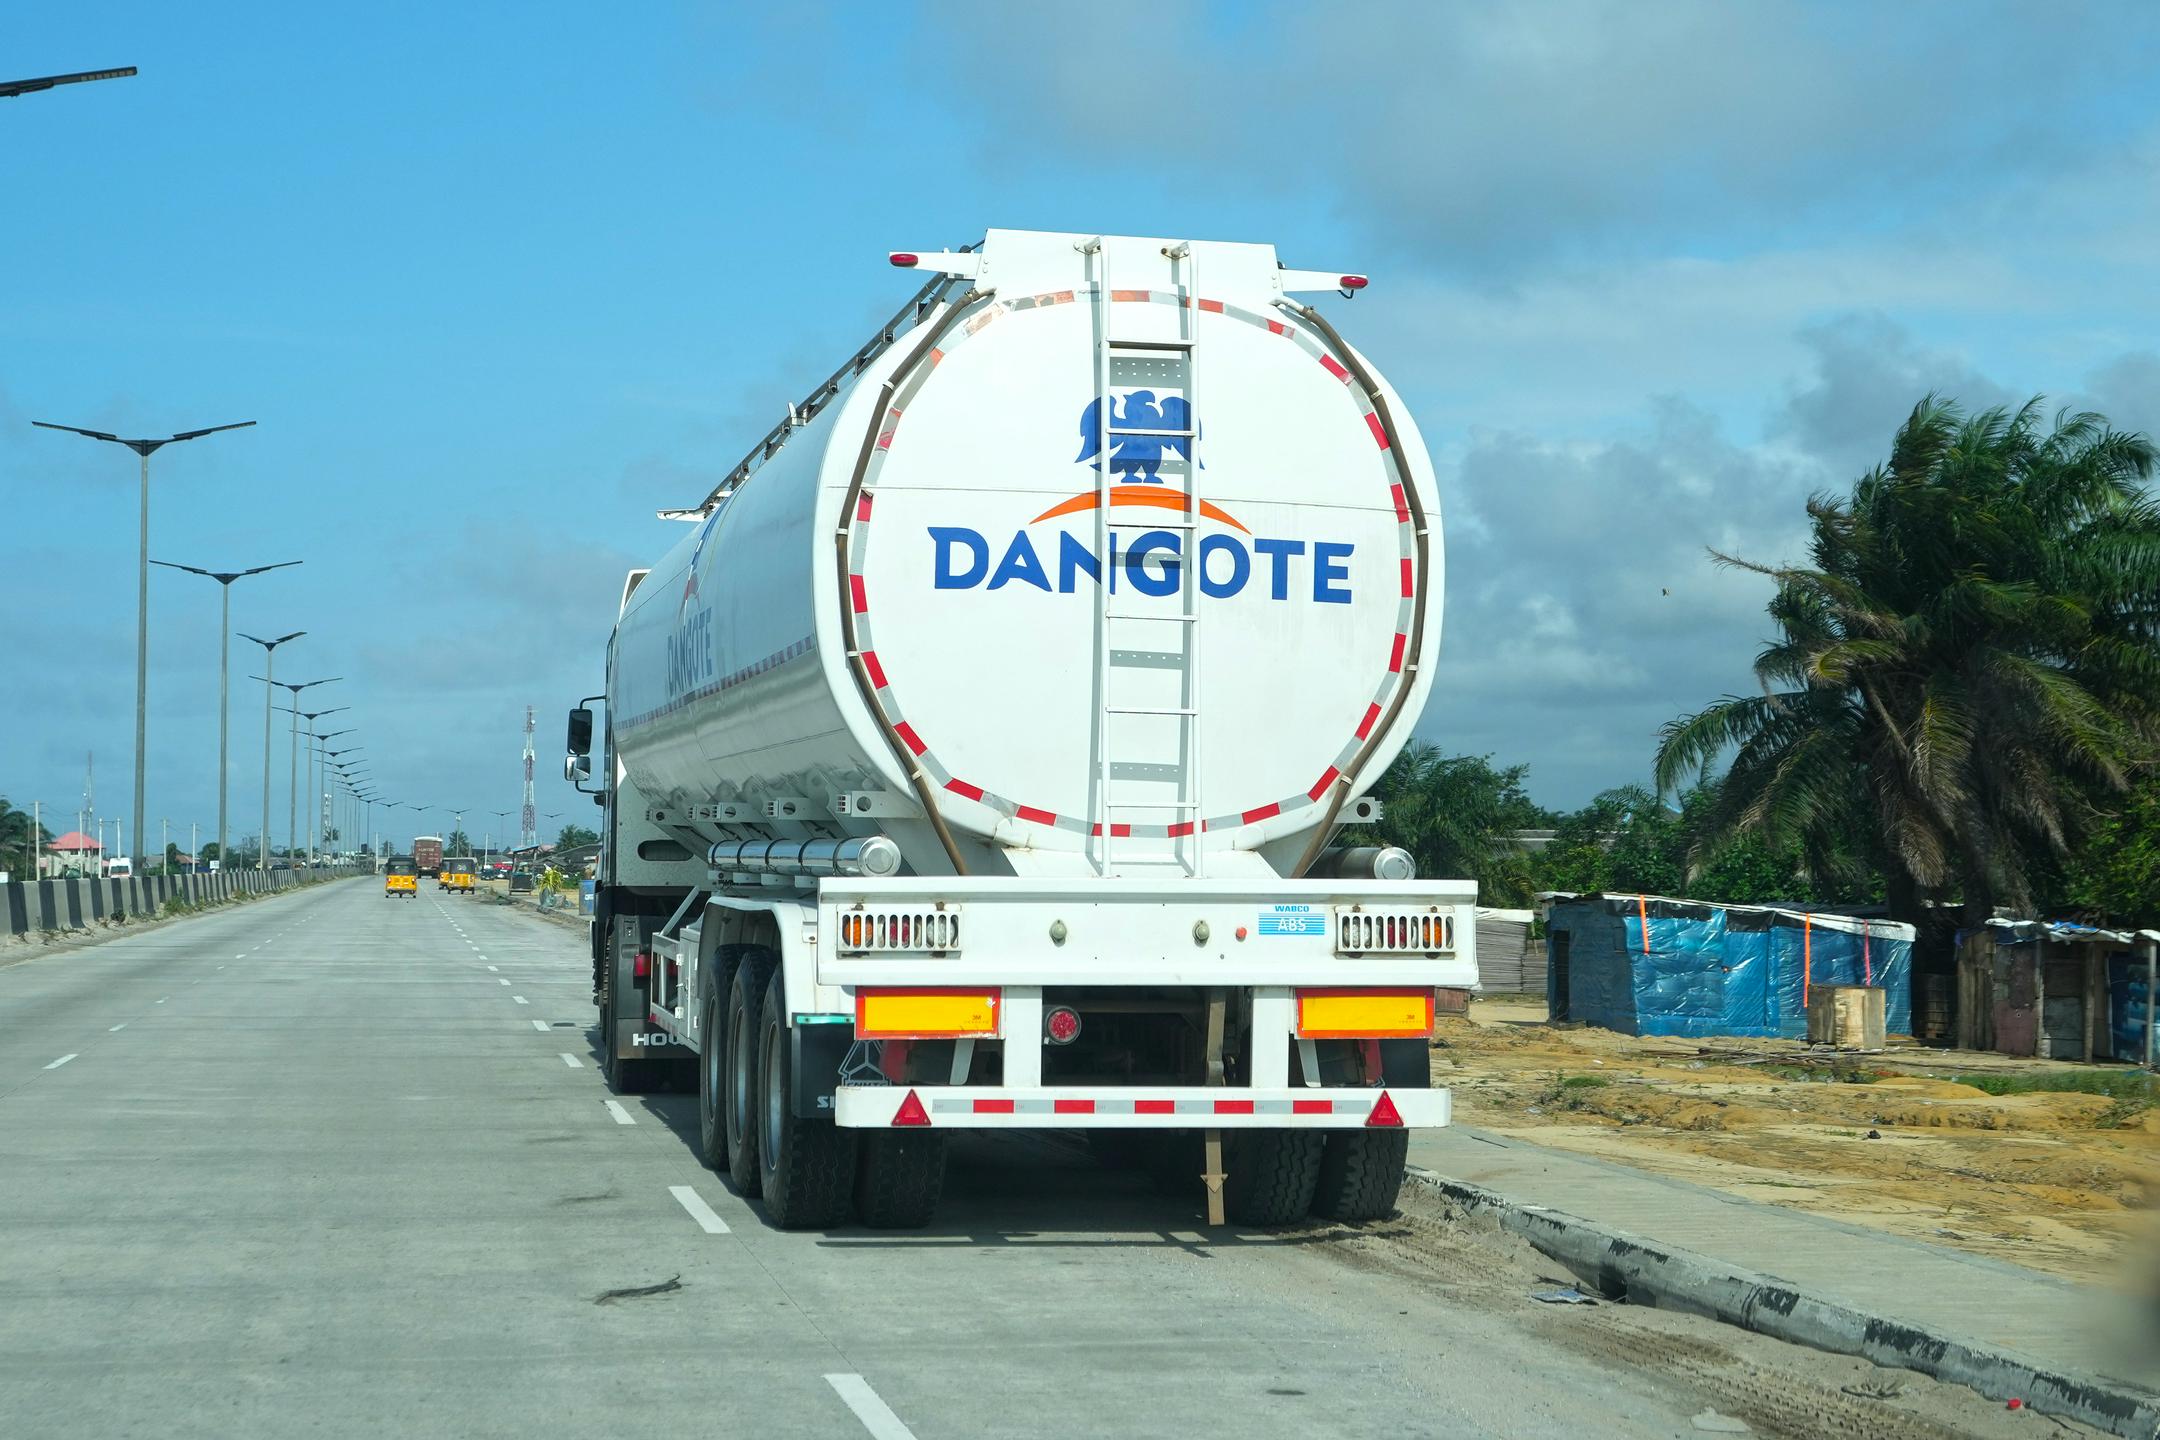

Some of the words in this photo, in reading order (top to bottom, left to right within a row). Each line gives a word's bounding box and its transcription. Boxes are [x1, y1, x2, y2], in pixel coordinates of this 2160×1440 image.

[927, 526, 1355, 604] DANGOTE
[668, 606, 713, 698] DANGOTE
[1274, 905, 1310, 913] WABCO
[1278, 917, 1307, 932] ABS
